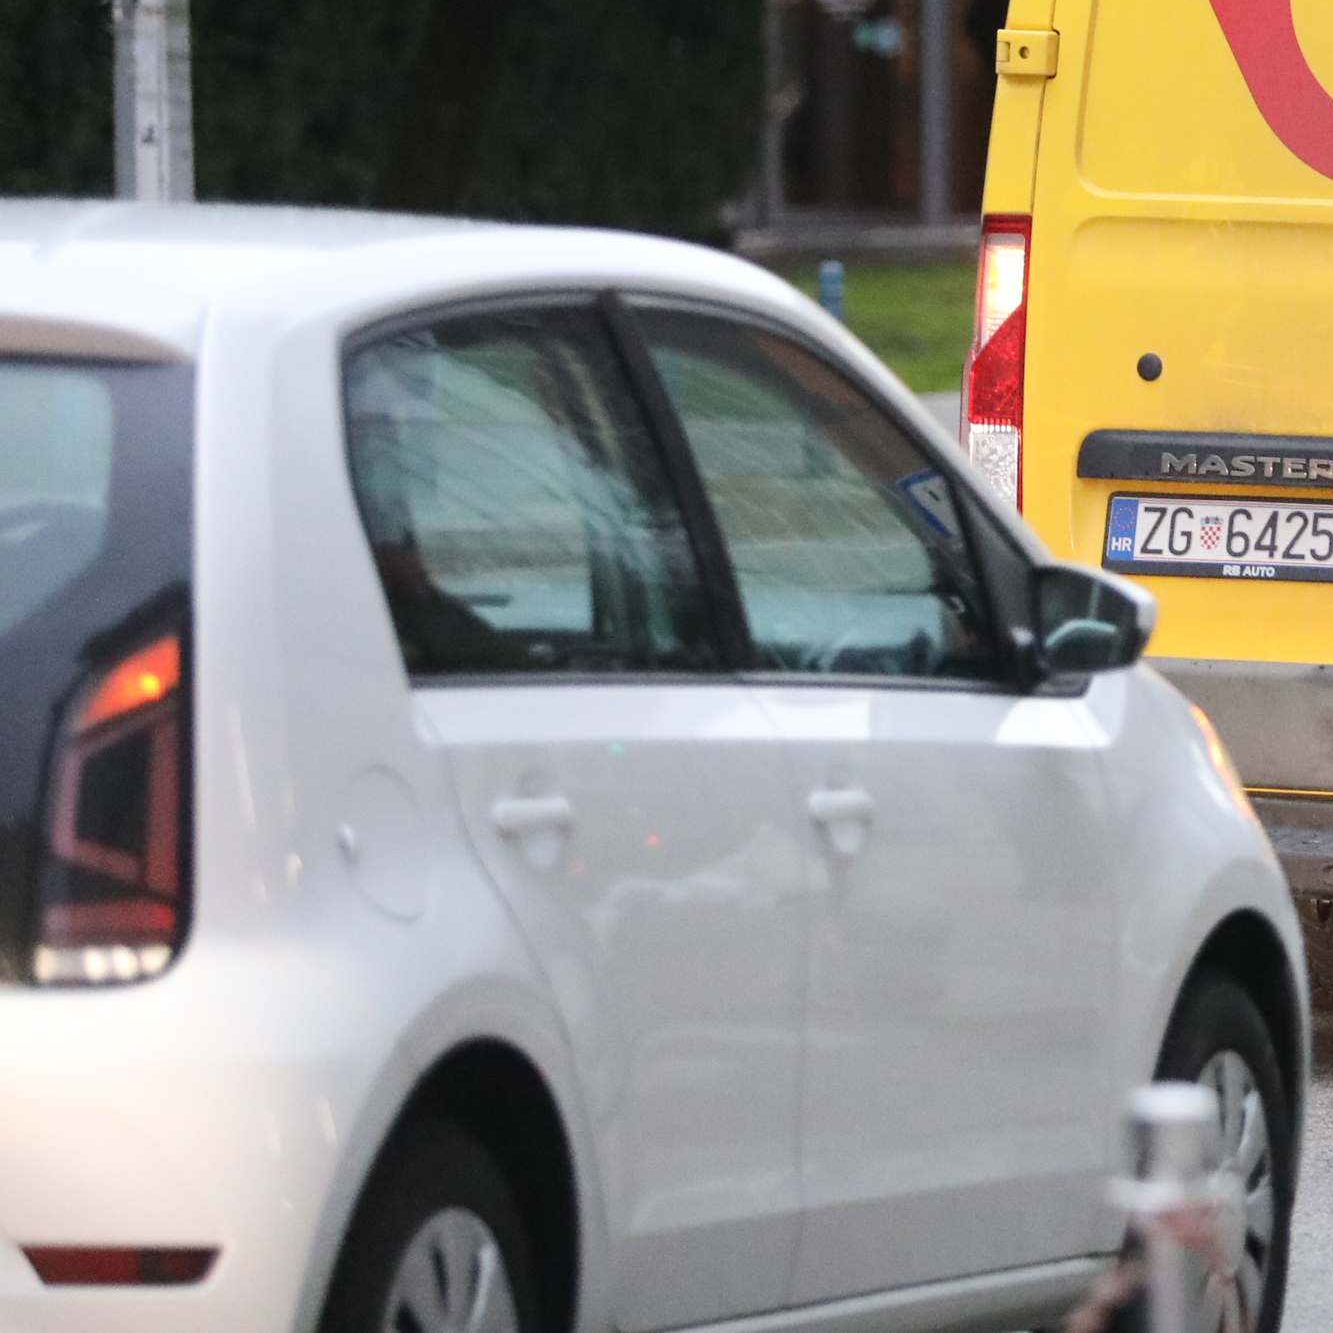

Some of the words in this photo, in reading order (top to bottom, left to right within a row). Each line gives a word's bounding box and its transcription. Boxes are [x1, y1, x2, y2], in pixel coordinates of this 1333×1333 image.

[1111, 536, 1132, 552] HR
[1139, 506, 1194, 556] ZG
[1222, 564, 1241, 576] RB
[1242, 565, 1275, 577] AUTO
